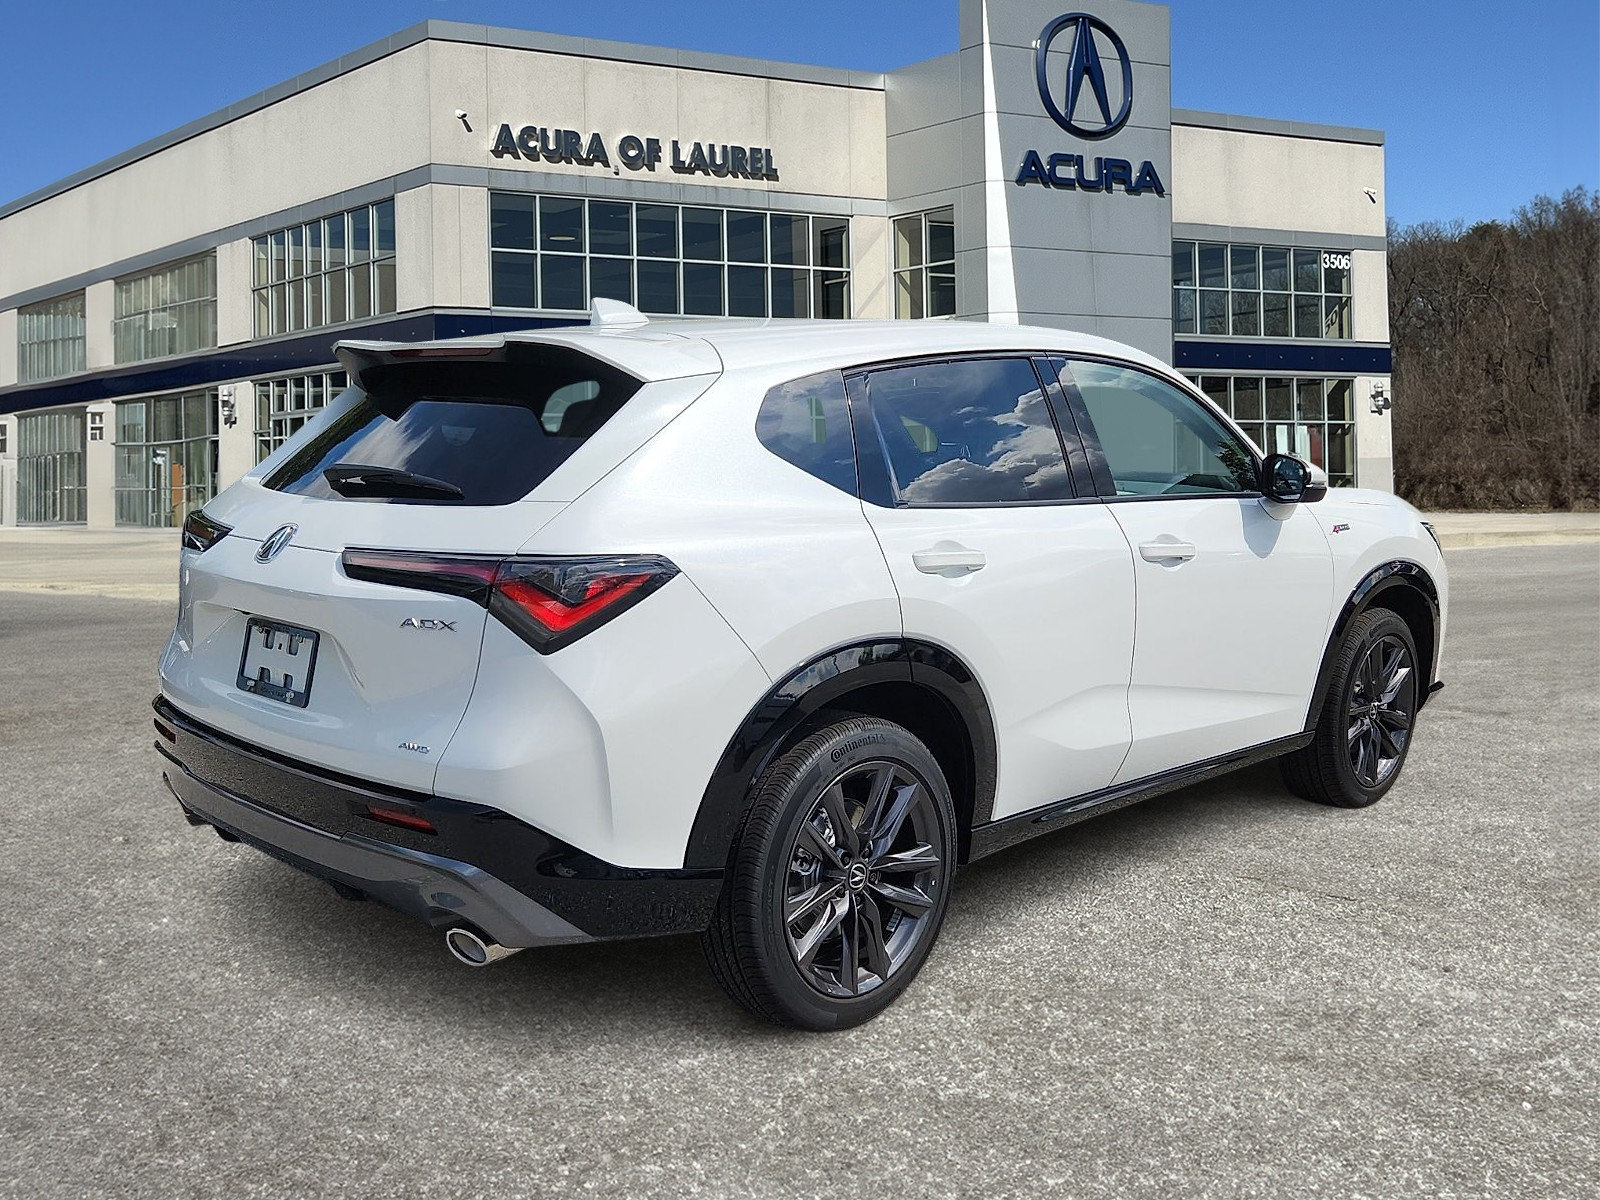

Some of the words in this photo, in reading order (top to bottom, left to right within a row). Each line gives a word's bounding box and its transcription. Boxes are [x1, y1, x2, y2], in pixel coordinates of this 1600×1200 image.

[490, 123, 610, 168] ACURA
[615, 135, 661, 172] OF
[670, 140, 779, 182] LAUREL
[1016, 150, 1165, 198] ACURA
[1322, 253, 1351, 270] 3506
[400, 617, 458, 633] ADX
[830, 733, 882, 762] Continental
